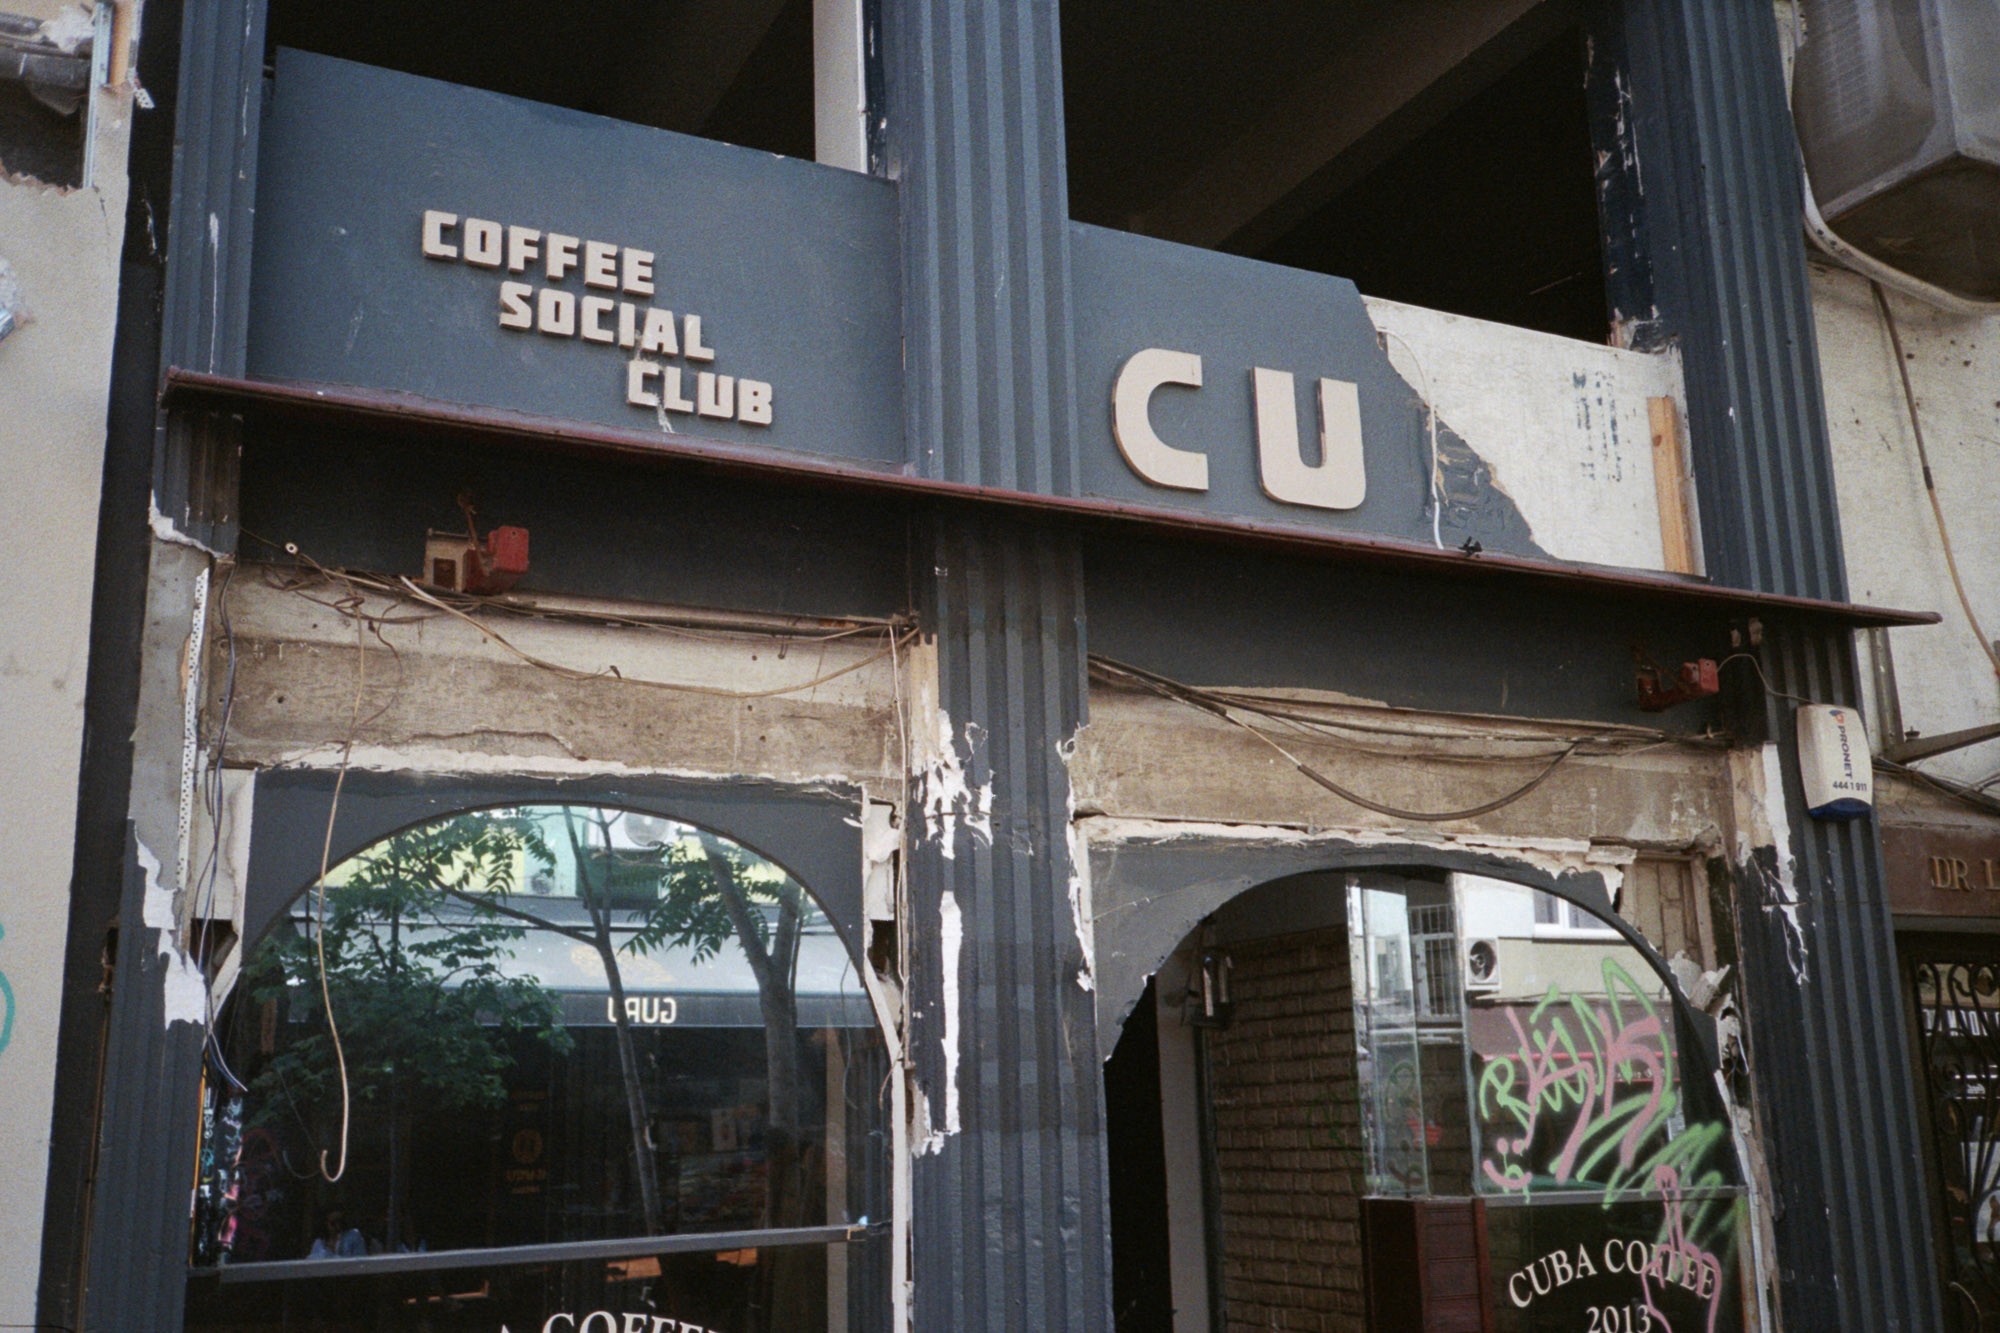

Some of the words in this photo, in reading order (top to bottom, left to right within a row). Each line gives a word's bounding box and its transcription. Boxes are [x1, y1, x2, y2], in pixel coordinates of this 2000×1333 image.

[422, 209, 655, 295] COFFEE
[500, 280, 715, 361] SOCIAL
[627, 359, 773, 425] CLUB
[1111, 347, 1367, 511] CU
[1837, 725, 1854, 780] PRONET
[1833, 781, 1849, 790] 444
[1855, 782, 1867, 791] 911
[1508, 1243, 1598, 1309] CUBA
[1586, 1304, 1652, 1333] 2013
